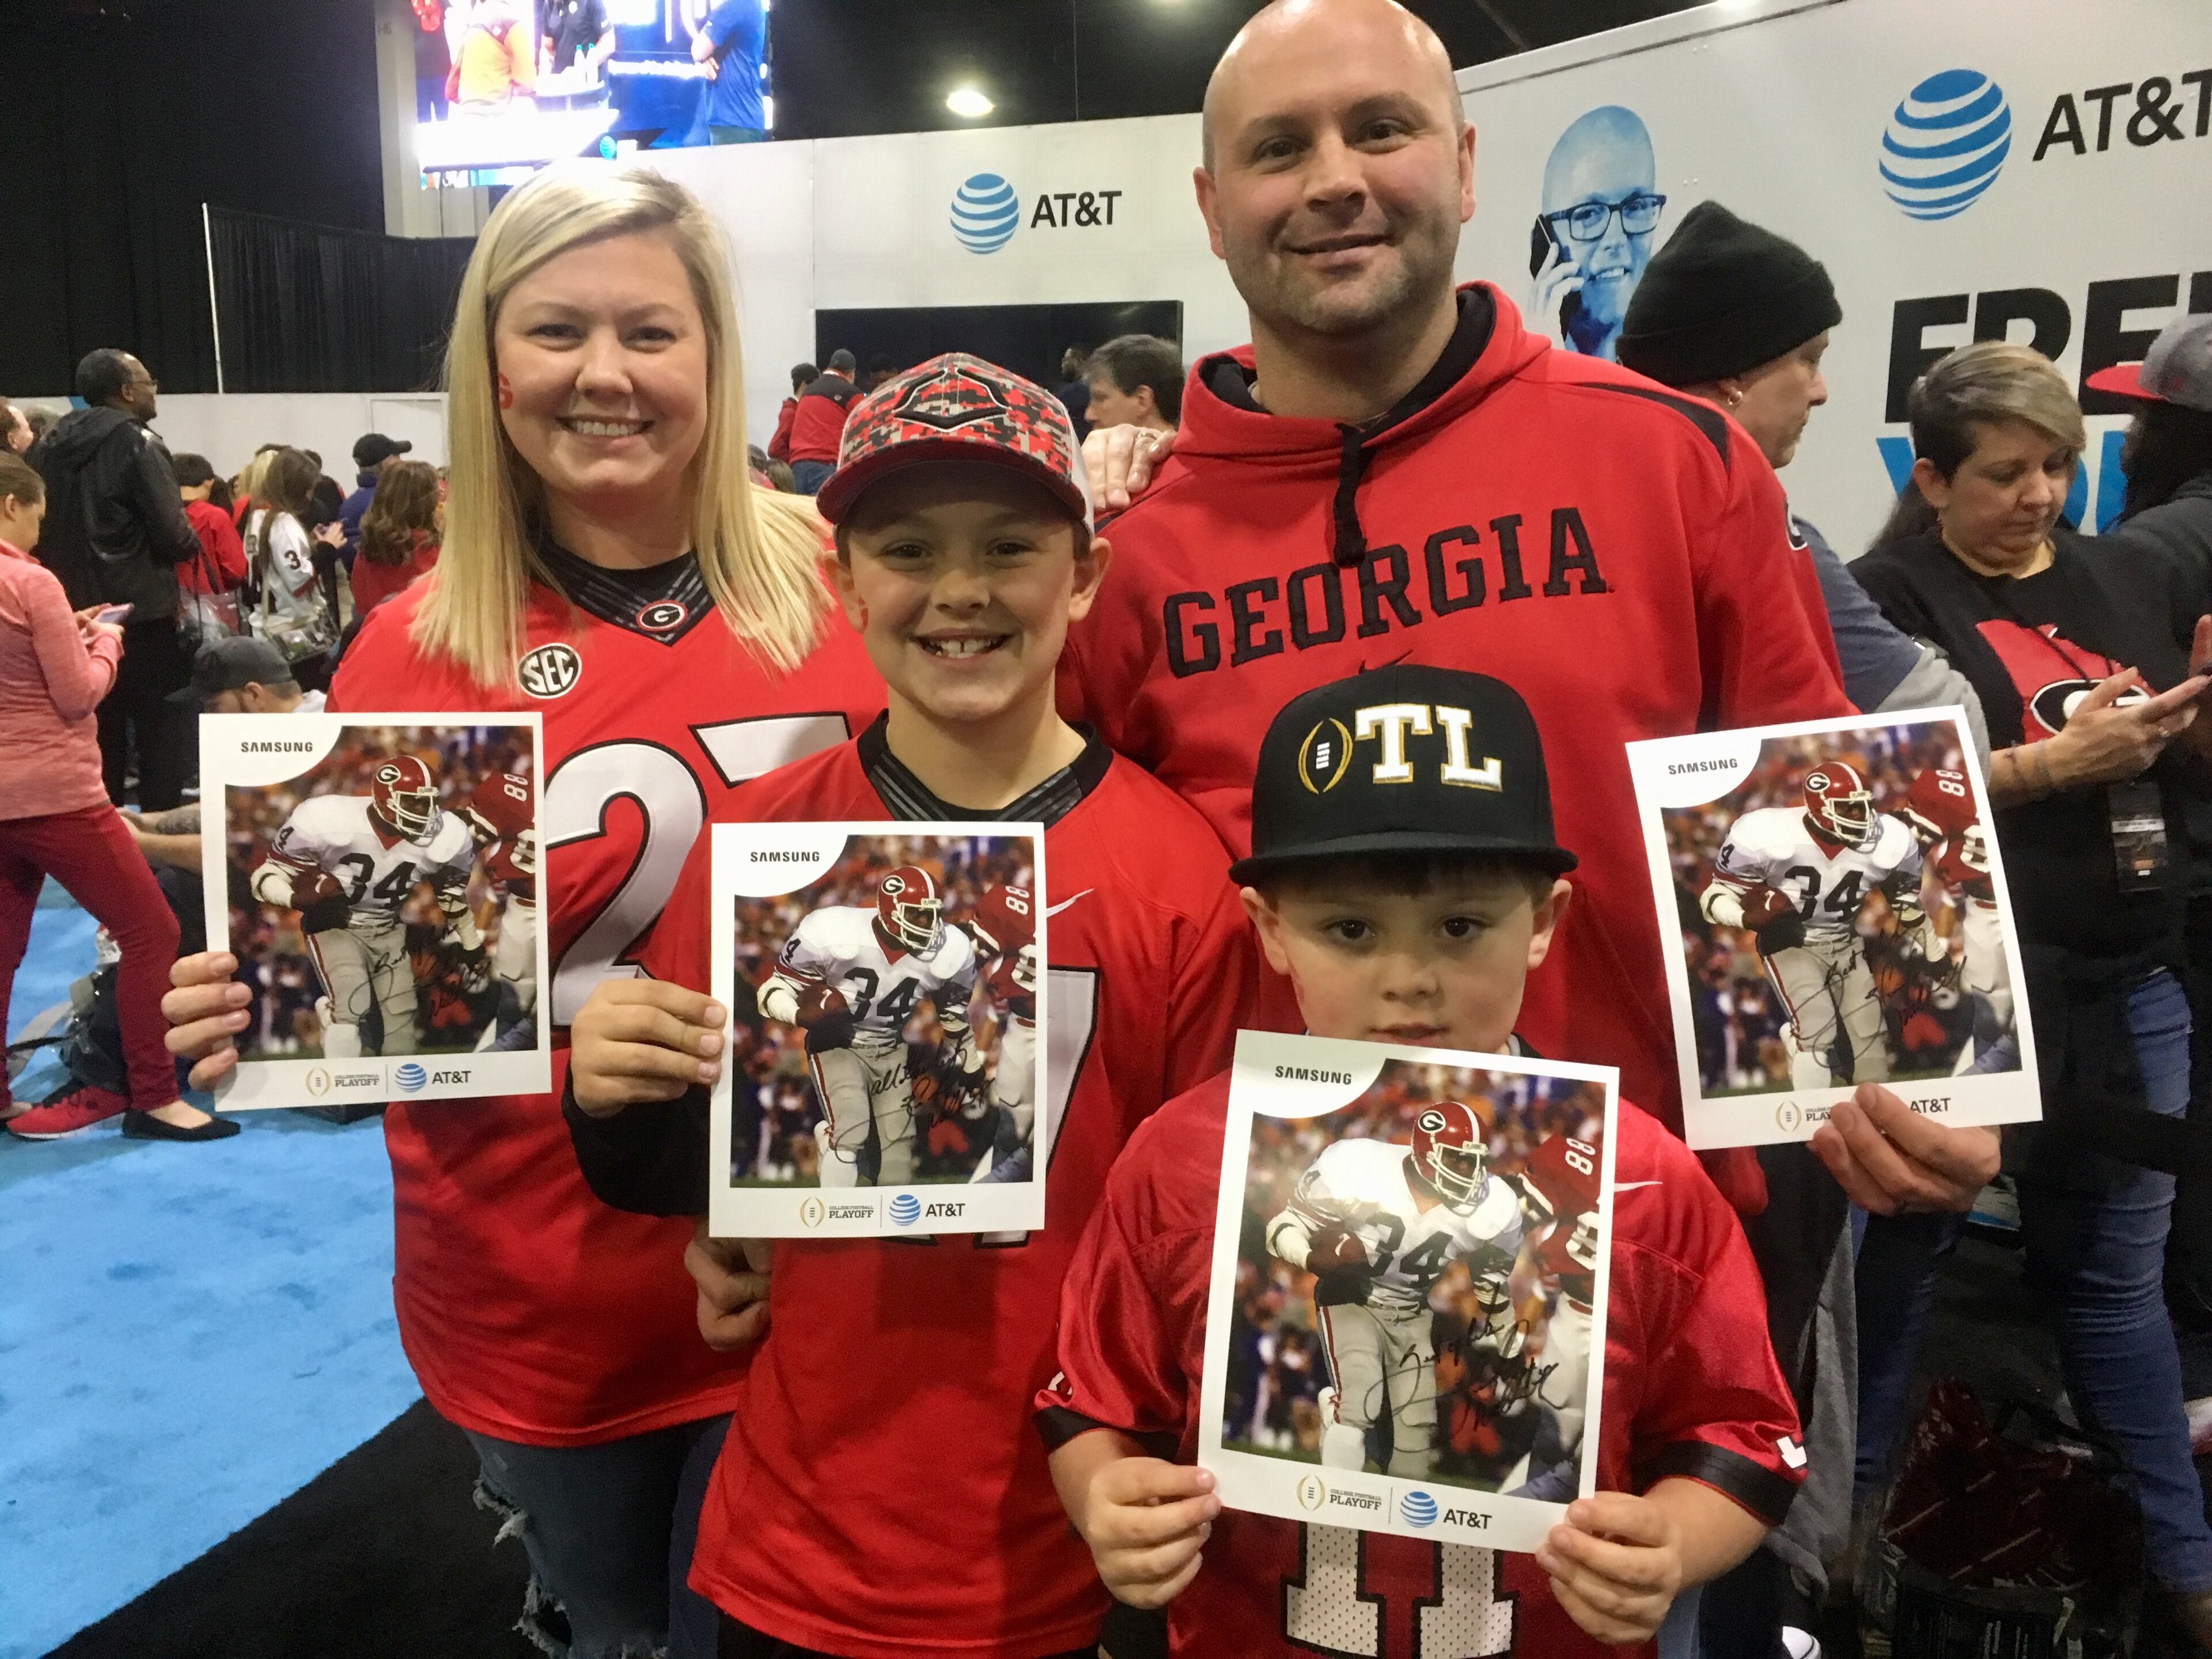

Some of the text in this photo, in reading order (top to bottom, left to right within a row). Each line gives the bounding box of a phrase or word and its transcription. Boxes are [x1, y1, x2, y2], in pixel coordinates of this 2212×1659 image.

[1031, 190, 1122, 229] AT&T
[1163, 507, 1607, 679] GEORGIA
[522, 649, 574, 693] SEC
[241, 742, 313, 752] SAMSUNG
[1668, 758, 1738, 775] SAMSUNG
[751, 851, 820, 862] SAMSUNG
[339, 853, 416, 908] 34
[1785, 865, 1863, 923] 34
[844, 967, 925, 1028] 34
[335, 1078, 380, 1087] PLAYOFF
[432, 1070, 471, 1084] AT&T
[1275, 1065, 1352, 1085] SAMSUNG
[1910, 1097, 1951, 1113] AT&T
[829, 1210, 874, 1218] PLAYOFF
[925, 1203, 965, 1217] AT&T
[1365, 1211, 1453, 1289] 34
[1330, 1494, 1381, 1510] PLAYOFF
[1443, 1509, 1493, 1529] AT&T
